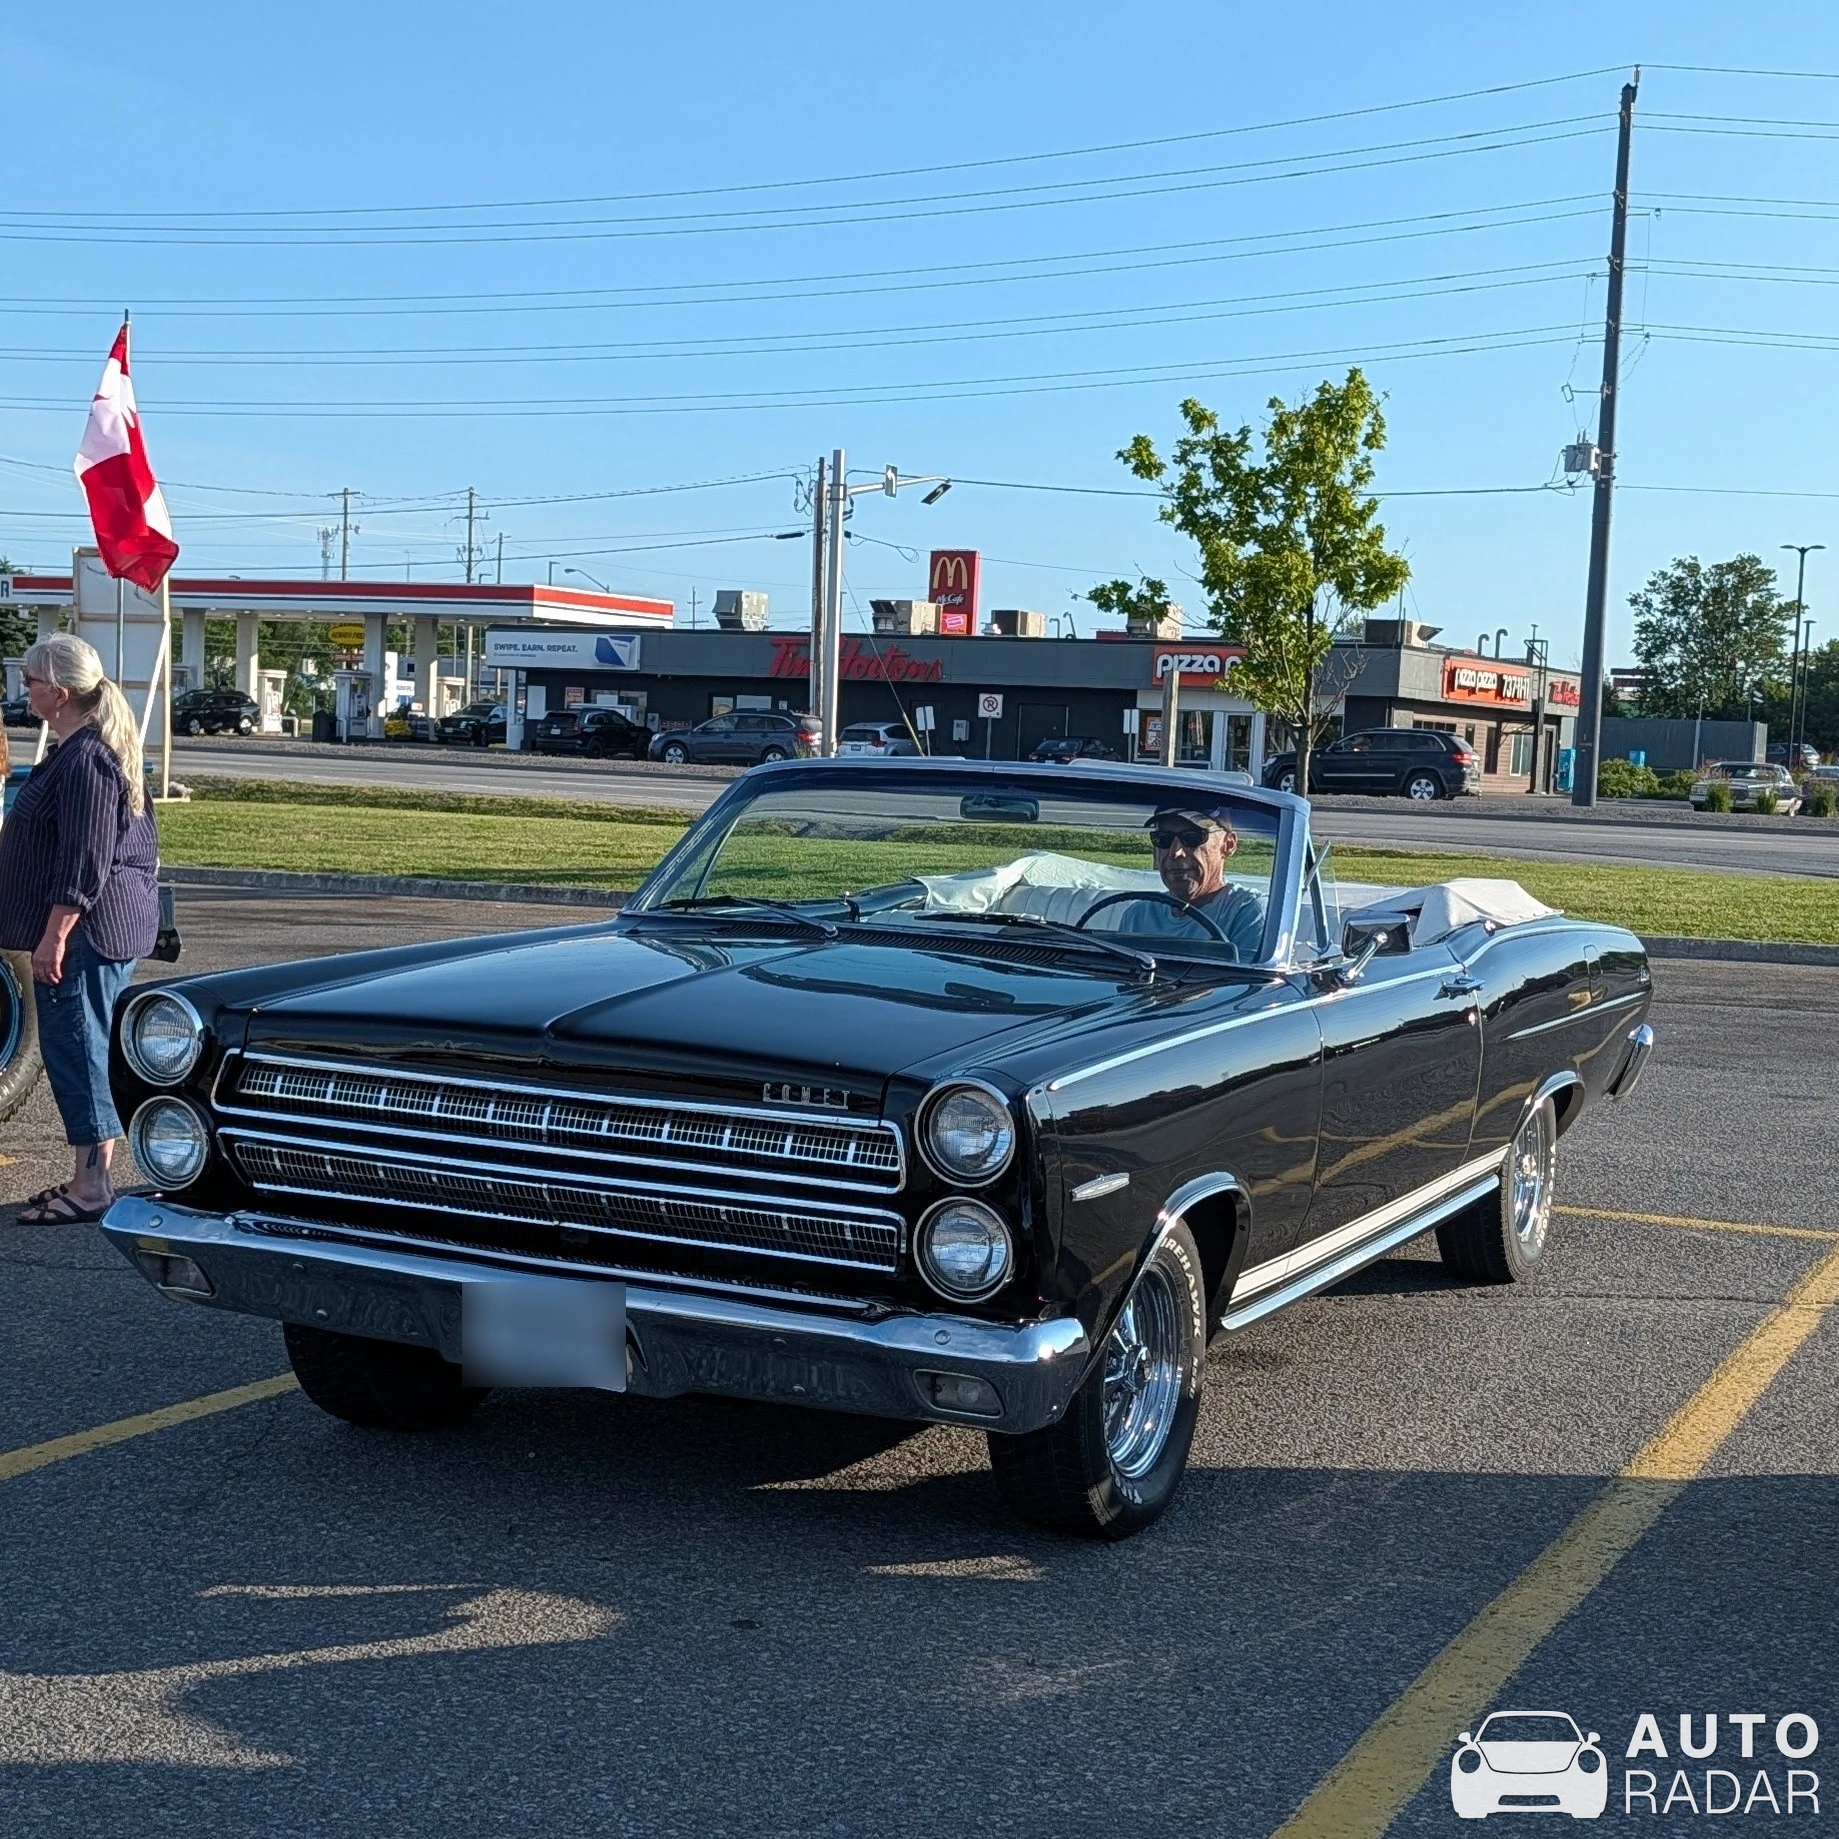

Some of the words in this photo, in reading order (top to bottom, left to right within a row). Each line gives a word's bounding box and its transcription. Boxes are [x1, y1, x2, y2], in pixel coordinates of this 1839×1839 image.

[494, 643, 519, 651] SWIPE.
[1156, 654, 1221, 679] pizza
[1454, 668, 1477, 692] pizza
[1476, 670, 1498, 693] pizza
[763, 1083, 850, 1110] COMET
[1160, 1237, 1201, 1338] IREHAWK
